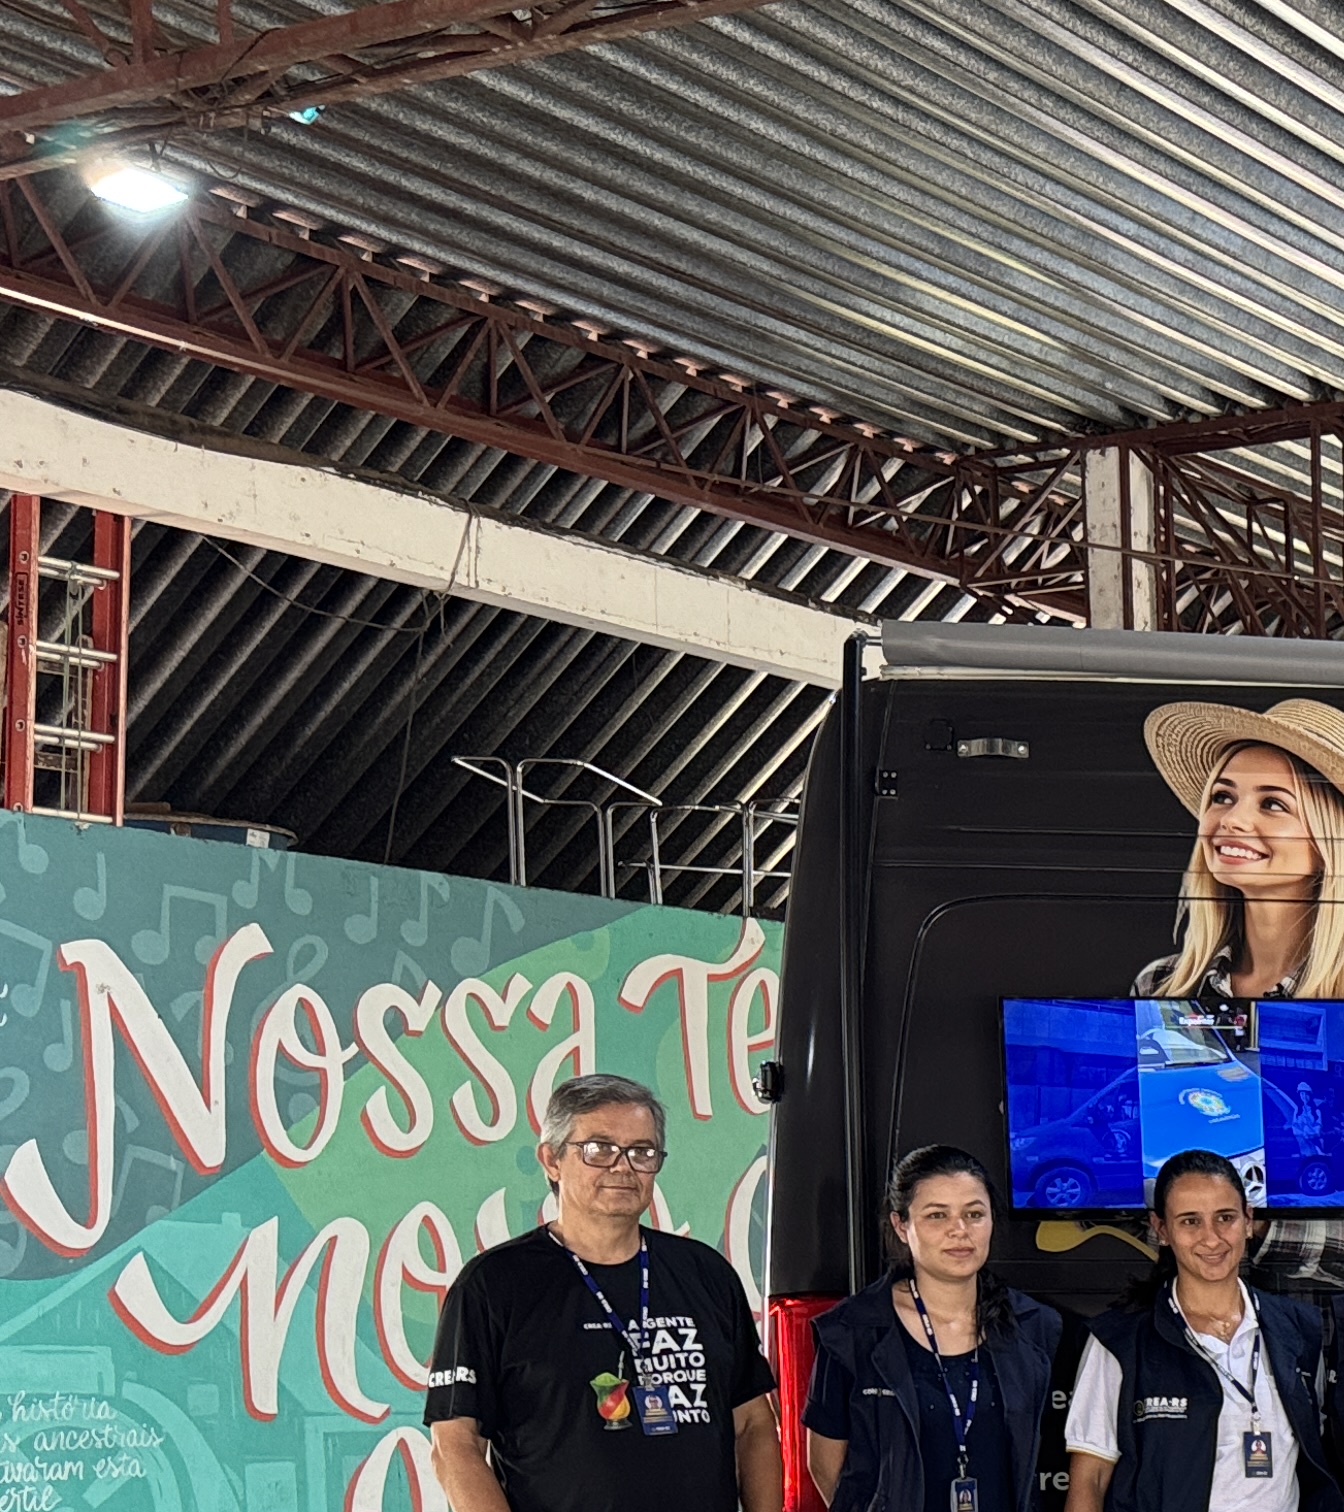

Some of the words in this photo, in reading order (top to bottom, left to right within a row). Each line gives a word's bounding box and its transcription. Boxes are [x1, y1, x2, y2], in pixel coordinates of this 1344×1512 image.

[645, 1315, 696, 1330] GENTE
[667, 1383, 709, 1410] AZ
[33, 1423, 165, 1452] ancestrais
[92, 1453, 147, 1479] esta
